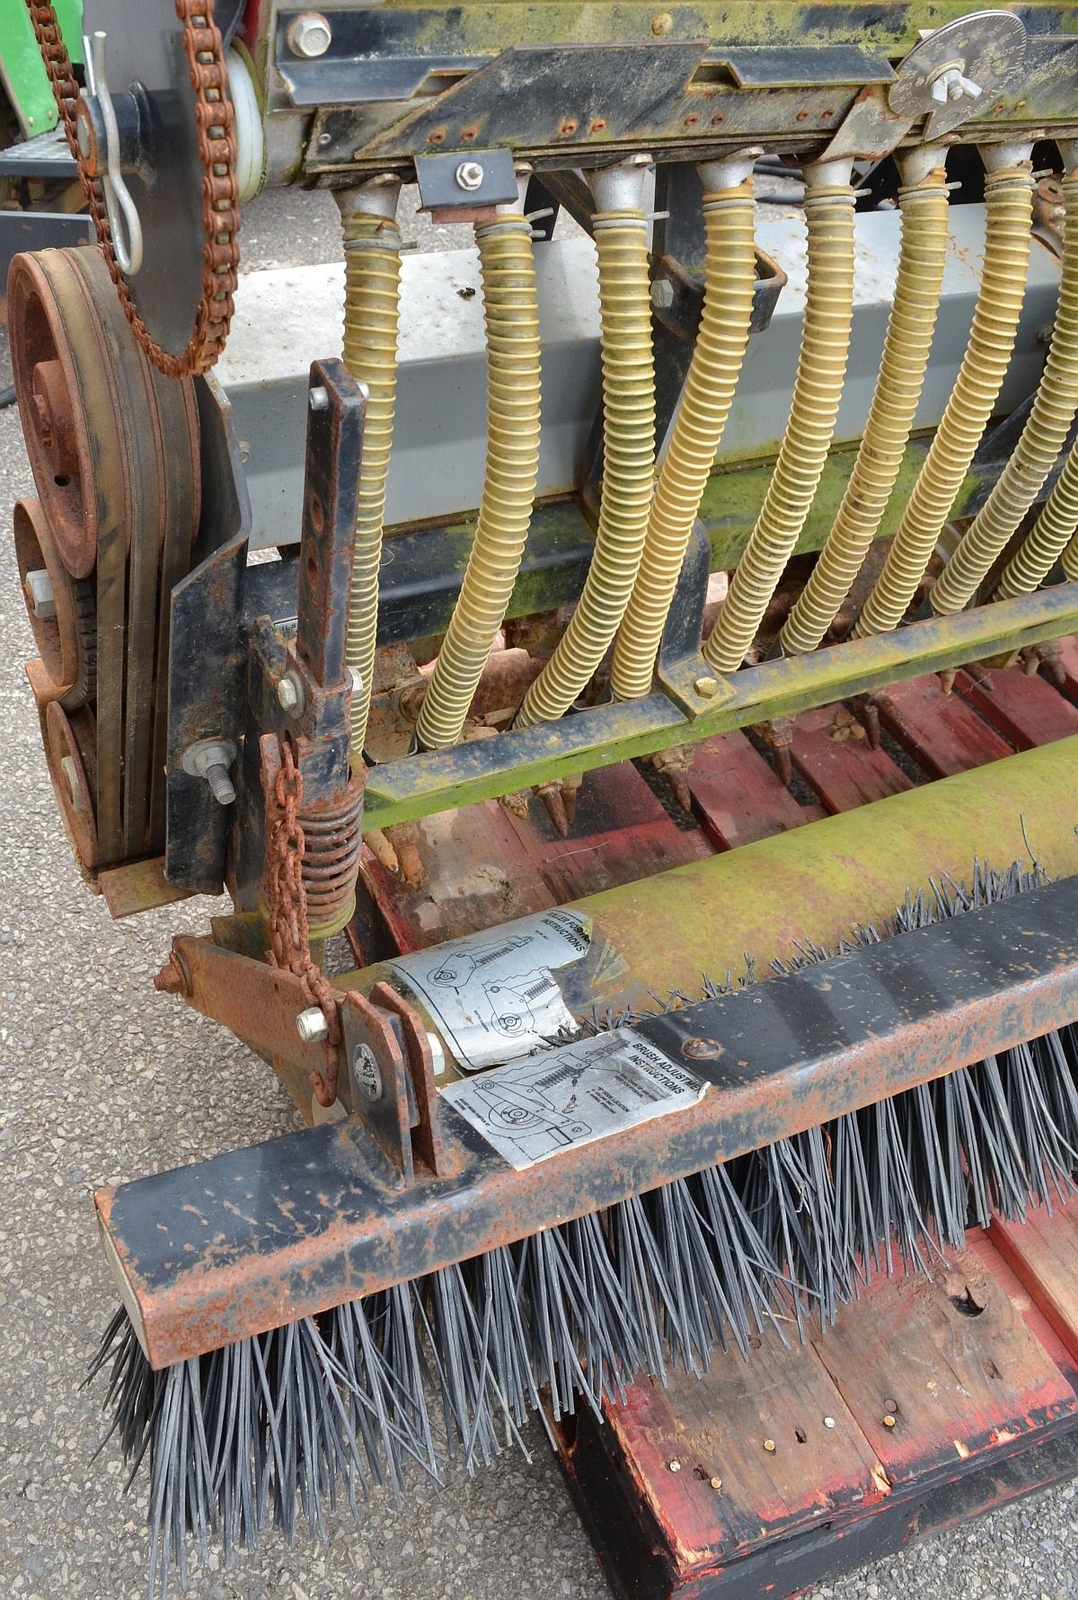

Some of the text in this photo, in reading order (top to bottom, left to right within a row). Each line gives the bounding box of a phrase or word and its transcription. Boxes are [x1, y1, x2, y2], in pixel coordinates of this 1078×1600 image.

[540, 919, 586, 952] INSTRUCTIONS
[628, 1054, 686, 1095] INSTRUCTIONS
[632, 1043, 702, 1093] BRUSH ADJUSTMEN
